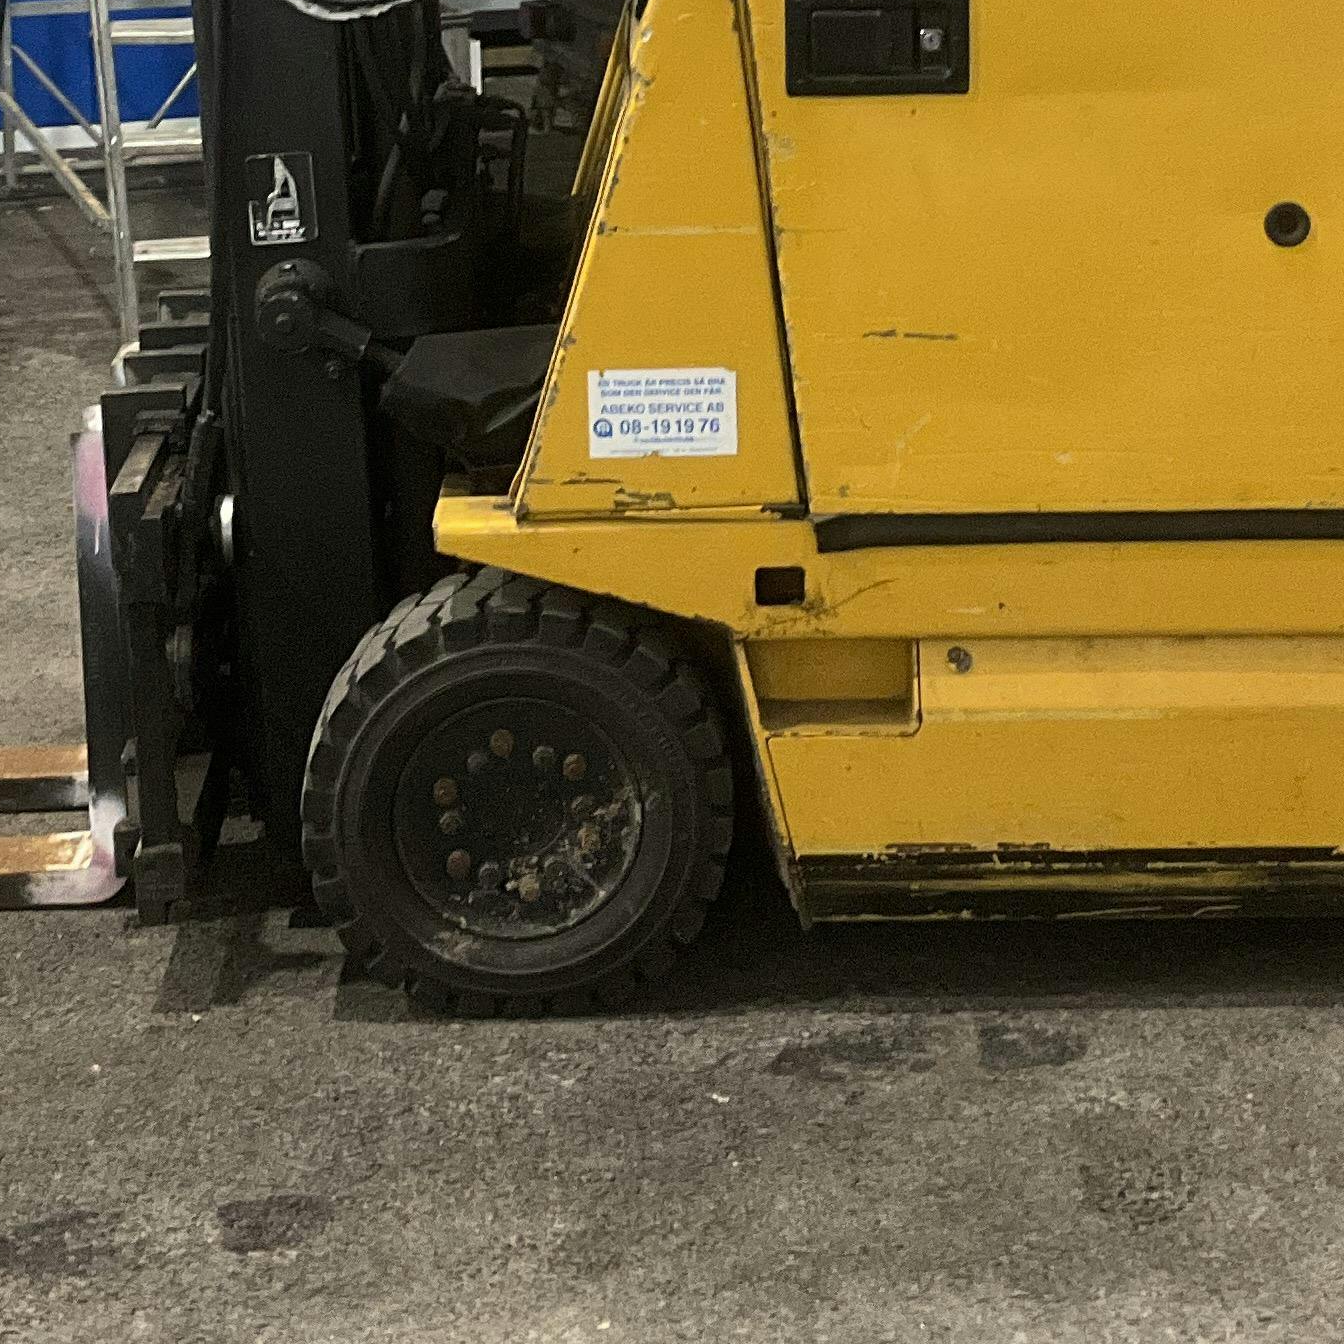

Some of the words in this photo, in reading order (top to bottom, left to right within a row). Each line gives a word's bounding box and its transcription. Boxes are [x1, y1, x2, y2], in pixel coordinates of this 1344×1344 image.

[600, 403, 645, 414] ABEKO
[648, 402, 704, 414] SERVICE
[706, 401, 725, 413] AB
